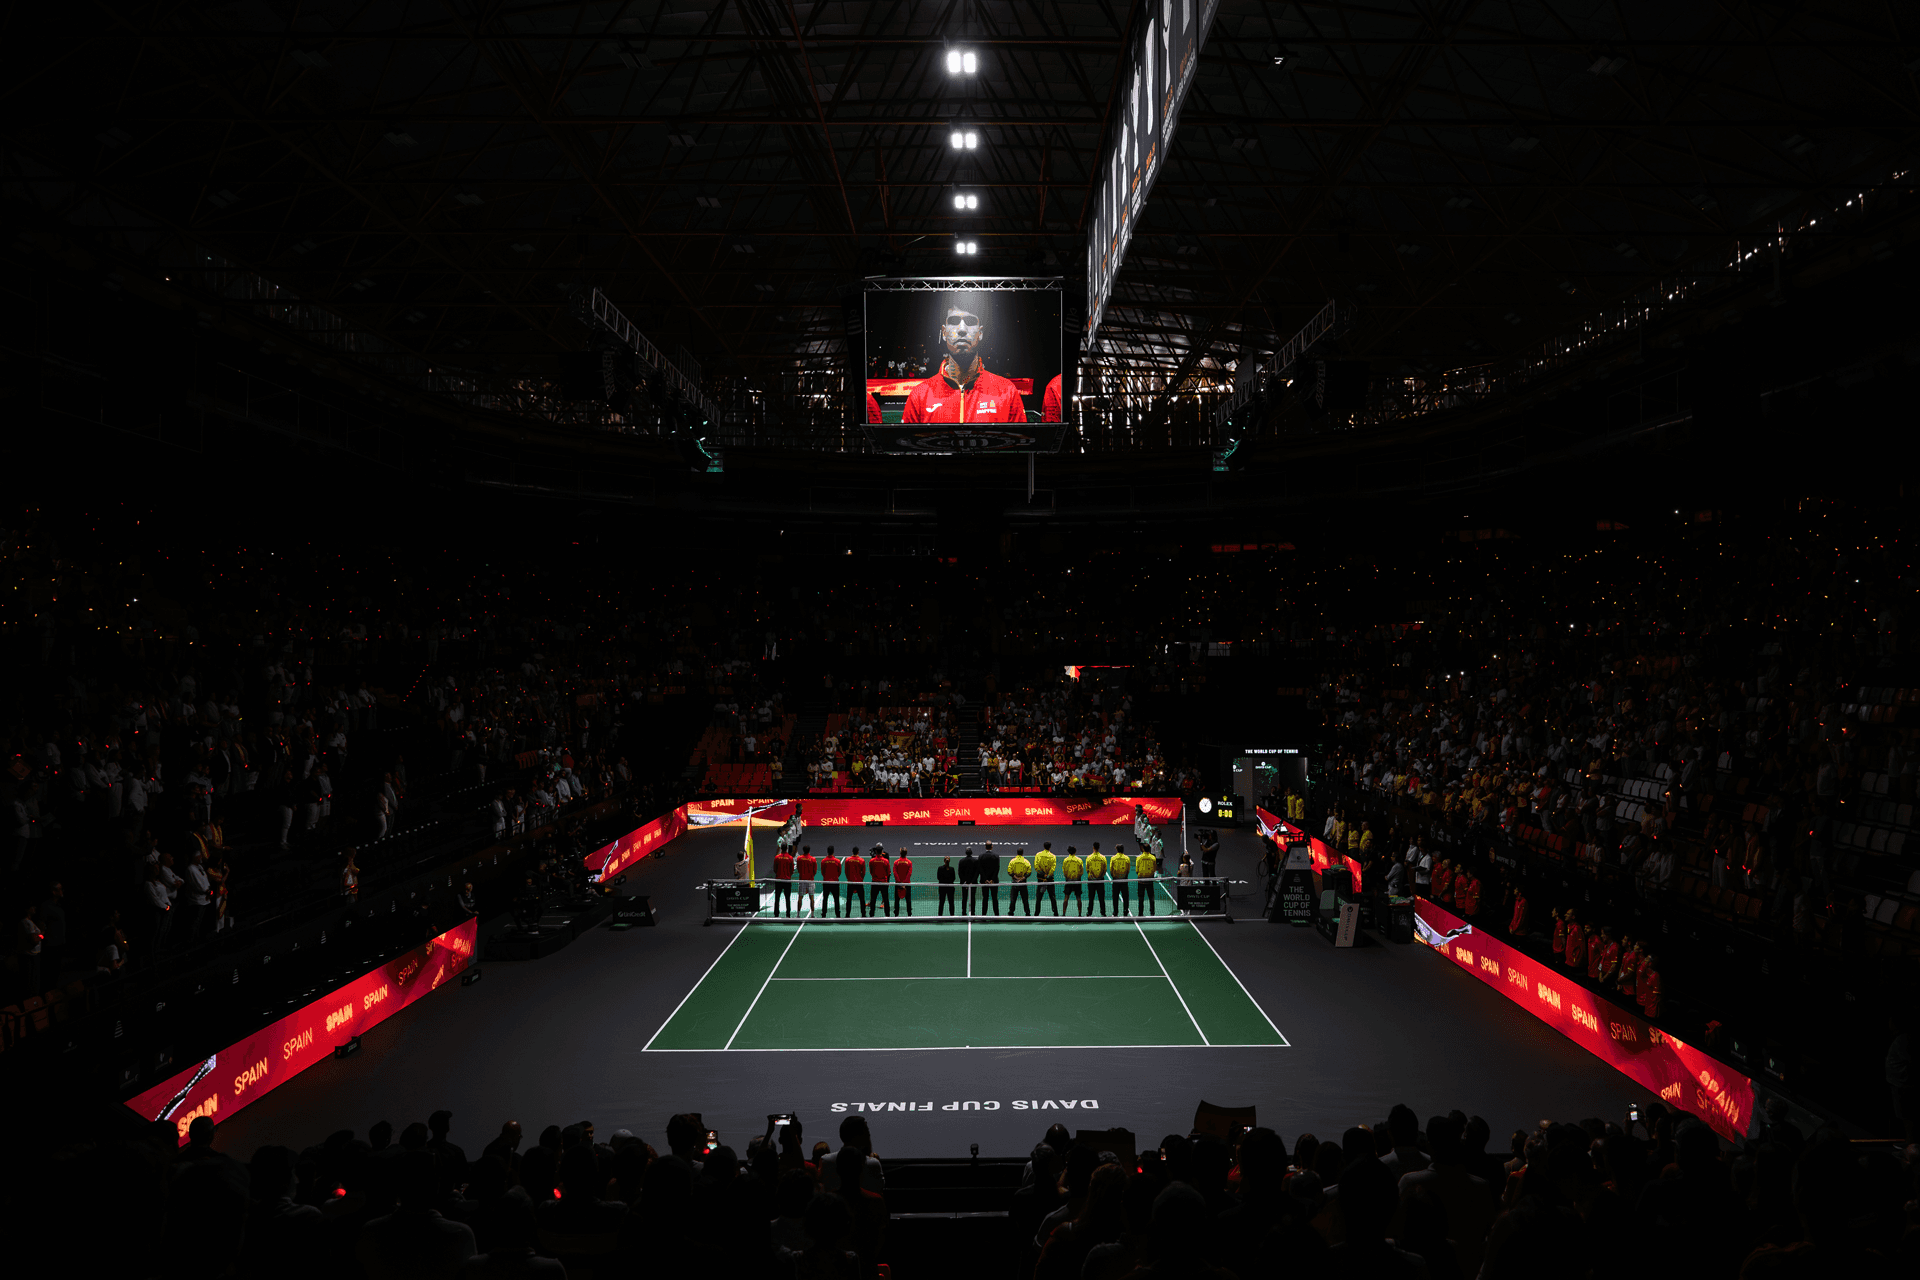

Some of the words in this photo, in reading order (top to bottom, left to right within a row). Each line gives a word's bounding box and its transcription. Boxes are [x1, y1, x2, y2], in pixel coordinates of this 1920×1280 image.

[711, 799, 734, 807] SPAIN
[821, 816, 848, 826] SPAIN
[862, 813, 890, 822] SPAIN
[903, 810, 930, 819] SPAIN
[944, 808, 970, 816] SPAIN
[984, 807, 1012, 816] SPAIN
[1025, 807, 1053, 815] SPAIN
[1066, 802, 1092, 813] SPAIN
[1283, 909, 1311, 917] TENNIS
[1456, 946, 1473, 966] SPAIN
[1480, 955, 1500, 977] SPAIN
[1507, 966, 1528, 991] SPAIN
[1538, 982, 1561, 1010] SPAIN
[1571, 1003, 1598, 1033] SPAIN
[1611, 1022, 1637, 1041] SPAIN
[234, 1057, 268, 1095] SPAIN
[283, 1027, 313, 1060] SPAIN
[326, 1002, 353, 1032] SPAIN
[363, 984, 388, 1010] SPAIN
[1699, 1070, 1740, 1124] SPAIN
[830, 1101, 933, 1112] FINALS
[941, 1100, 1000, 1111] CUP
[1012, 1099, 1099, 1110] DAVIS
